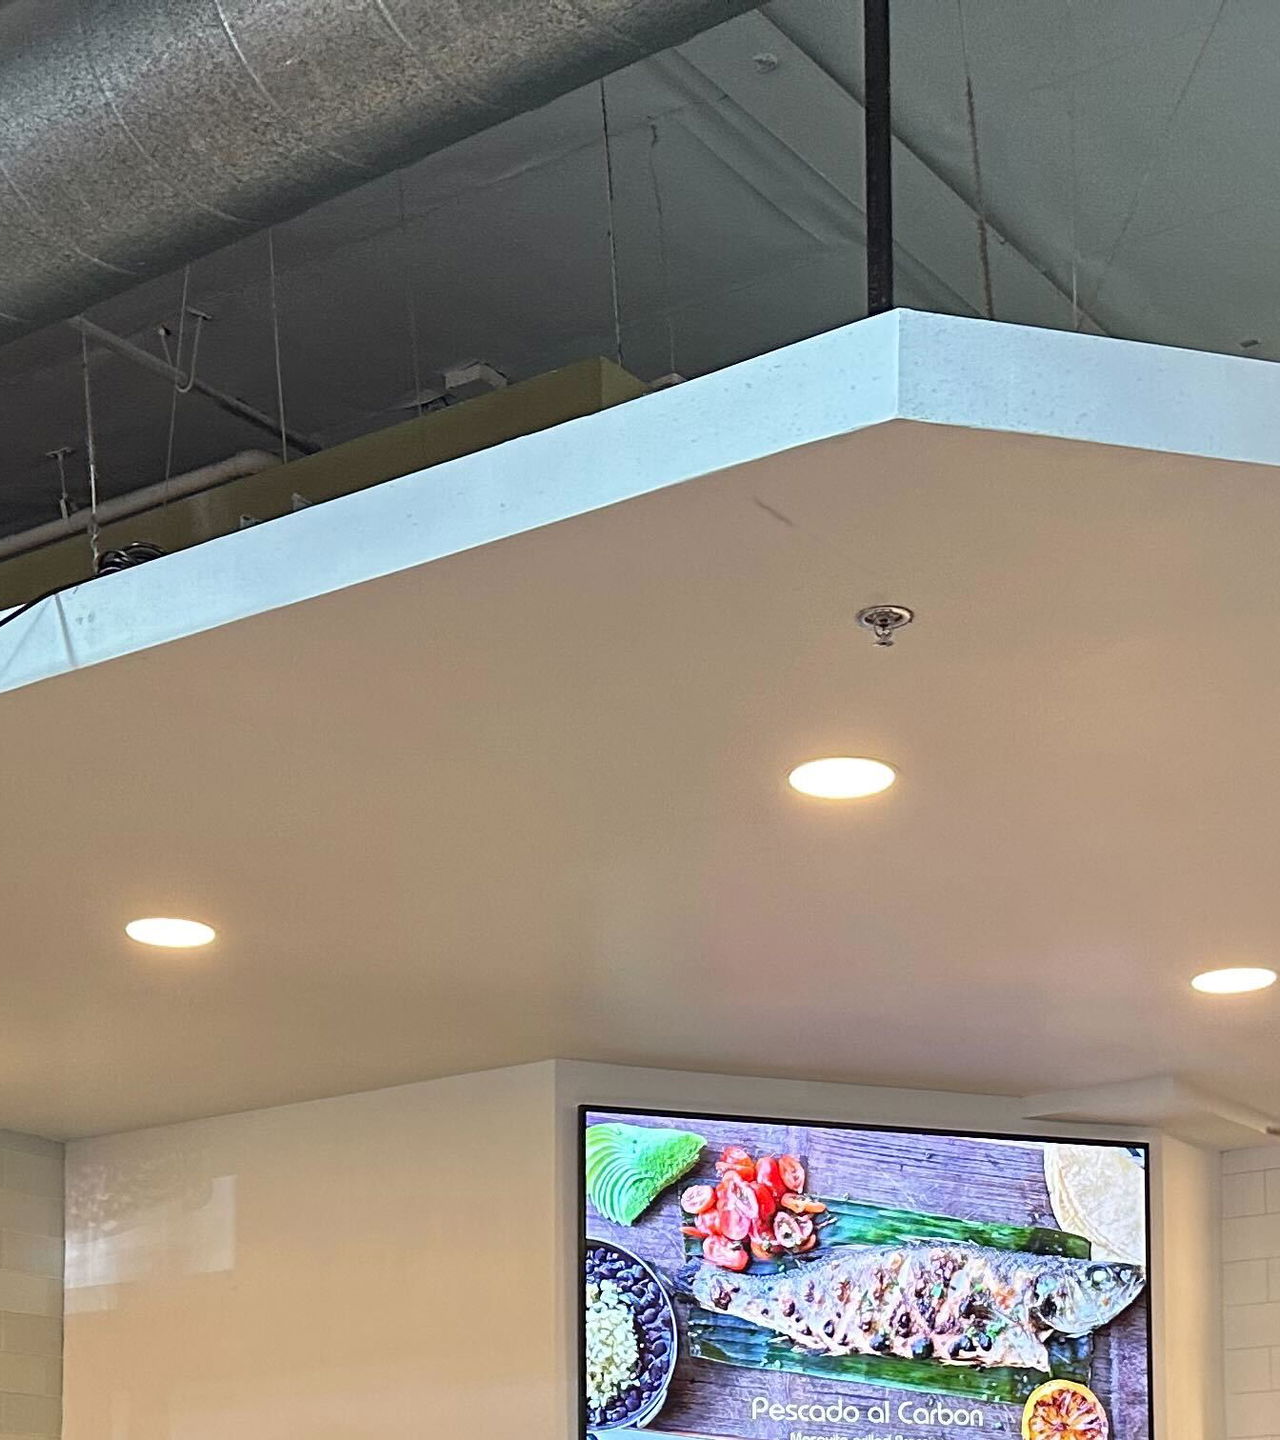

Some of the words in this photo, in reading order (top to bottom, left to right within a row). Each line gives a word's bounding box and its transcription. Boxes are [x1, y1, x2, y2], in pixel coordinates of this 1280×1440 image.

[751, 1396, 860, 1424] Pescado
[867, 1400, 891, 1425] al
[897, 1401, 985, 1428] Carbon
